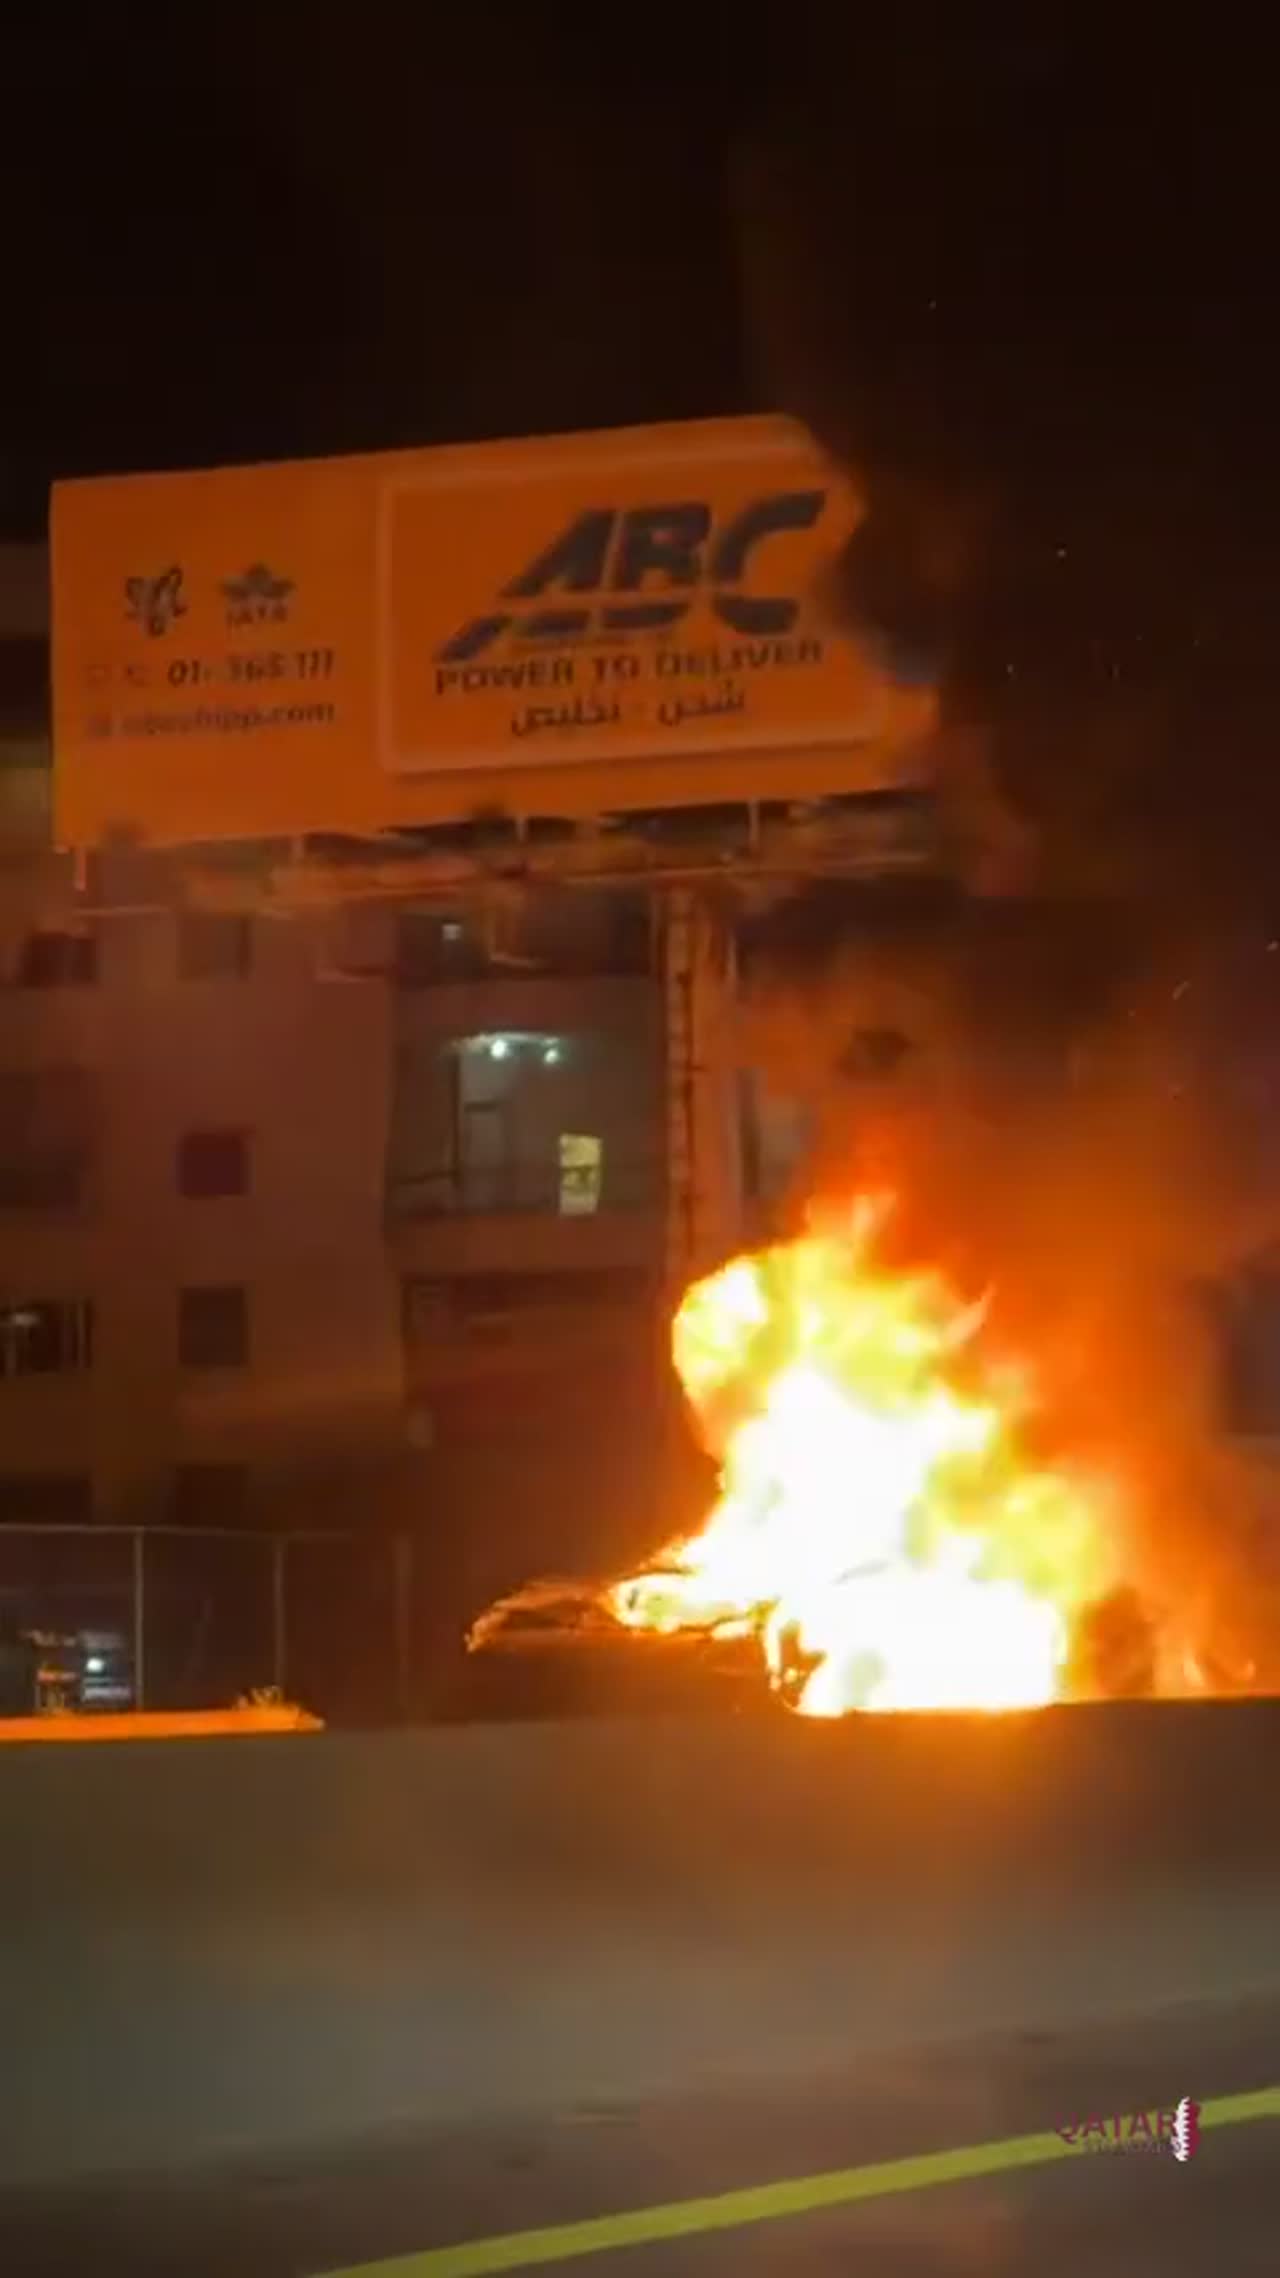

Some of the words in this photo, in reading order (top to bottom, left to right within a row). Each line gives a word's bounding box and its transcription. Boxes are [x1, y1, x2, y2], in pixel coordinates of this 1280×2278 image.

[436, 489, 827, 661] ABC
[435, 660, 575, 695] POWER
[592, 654, 640, 682] TO
[655, 638, 823, 680] DELIVER
